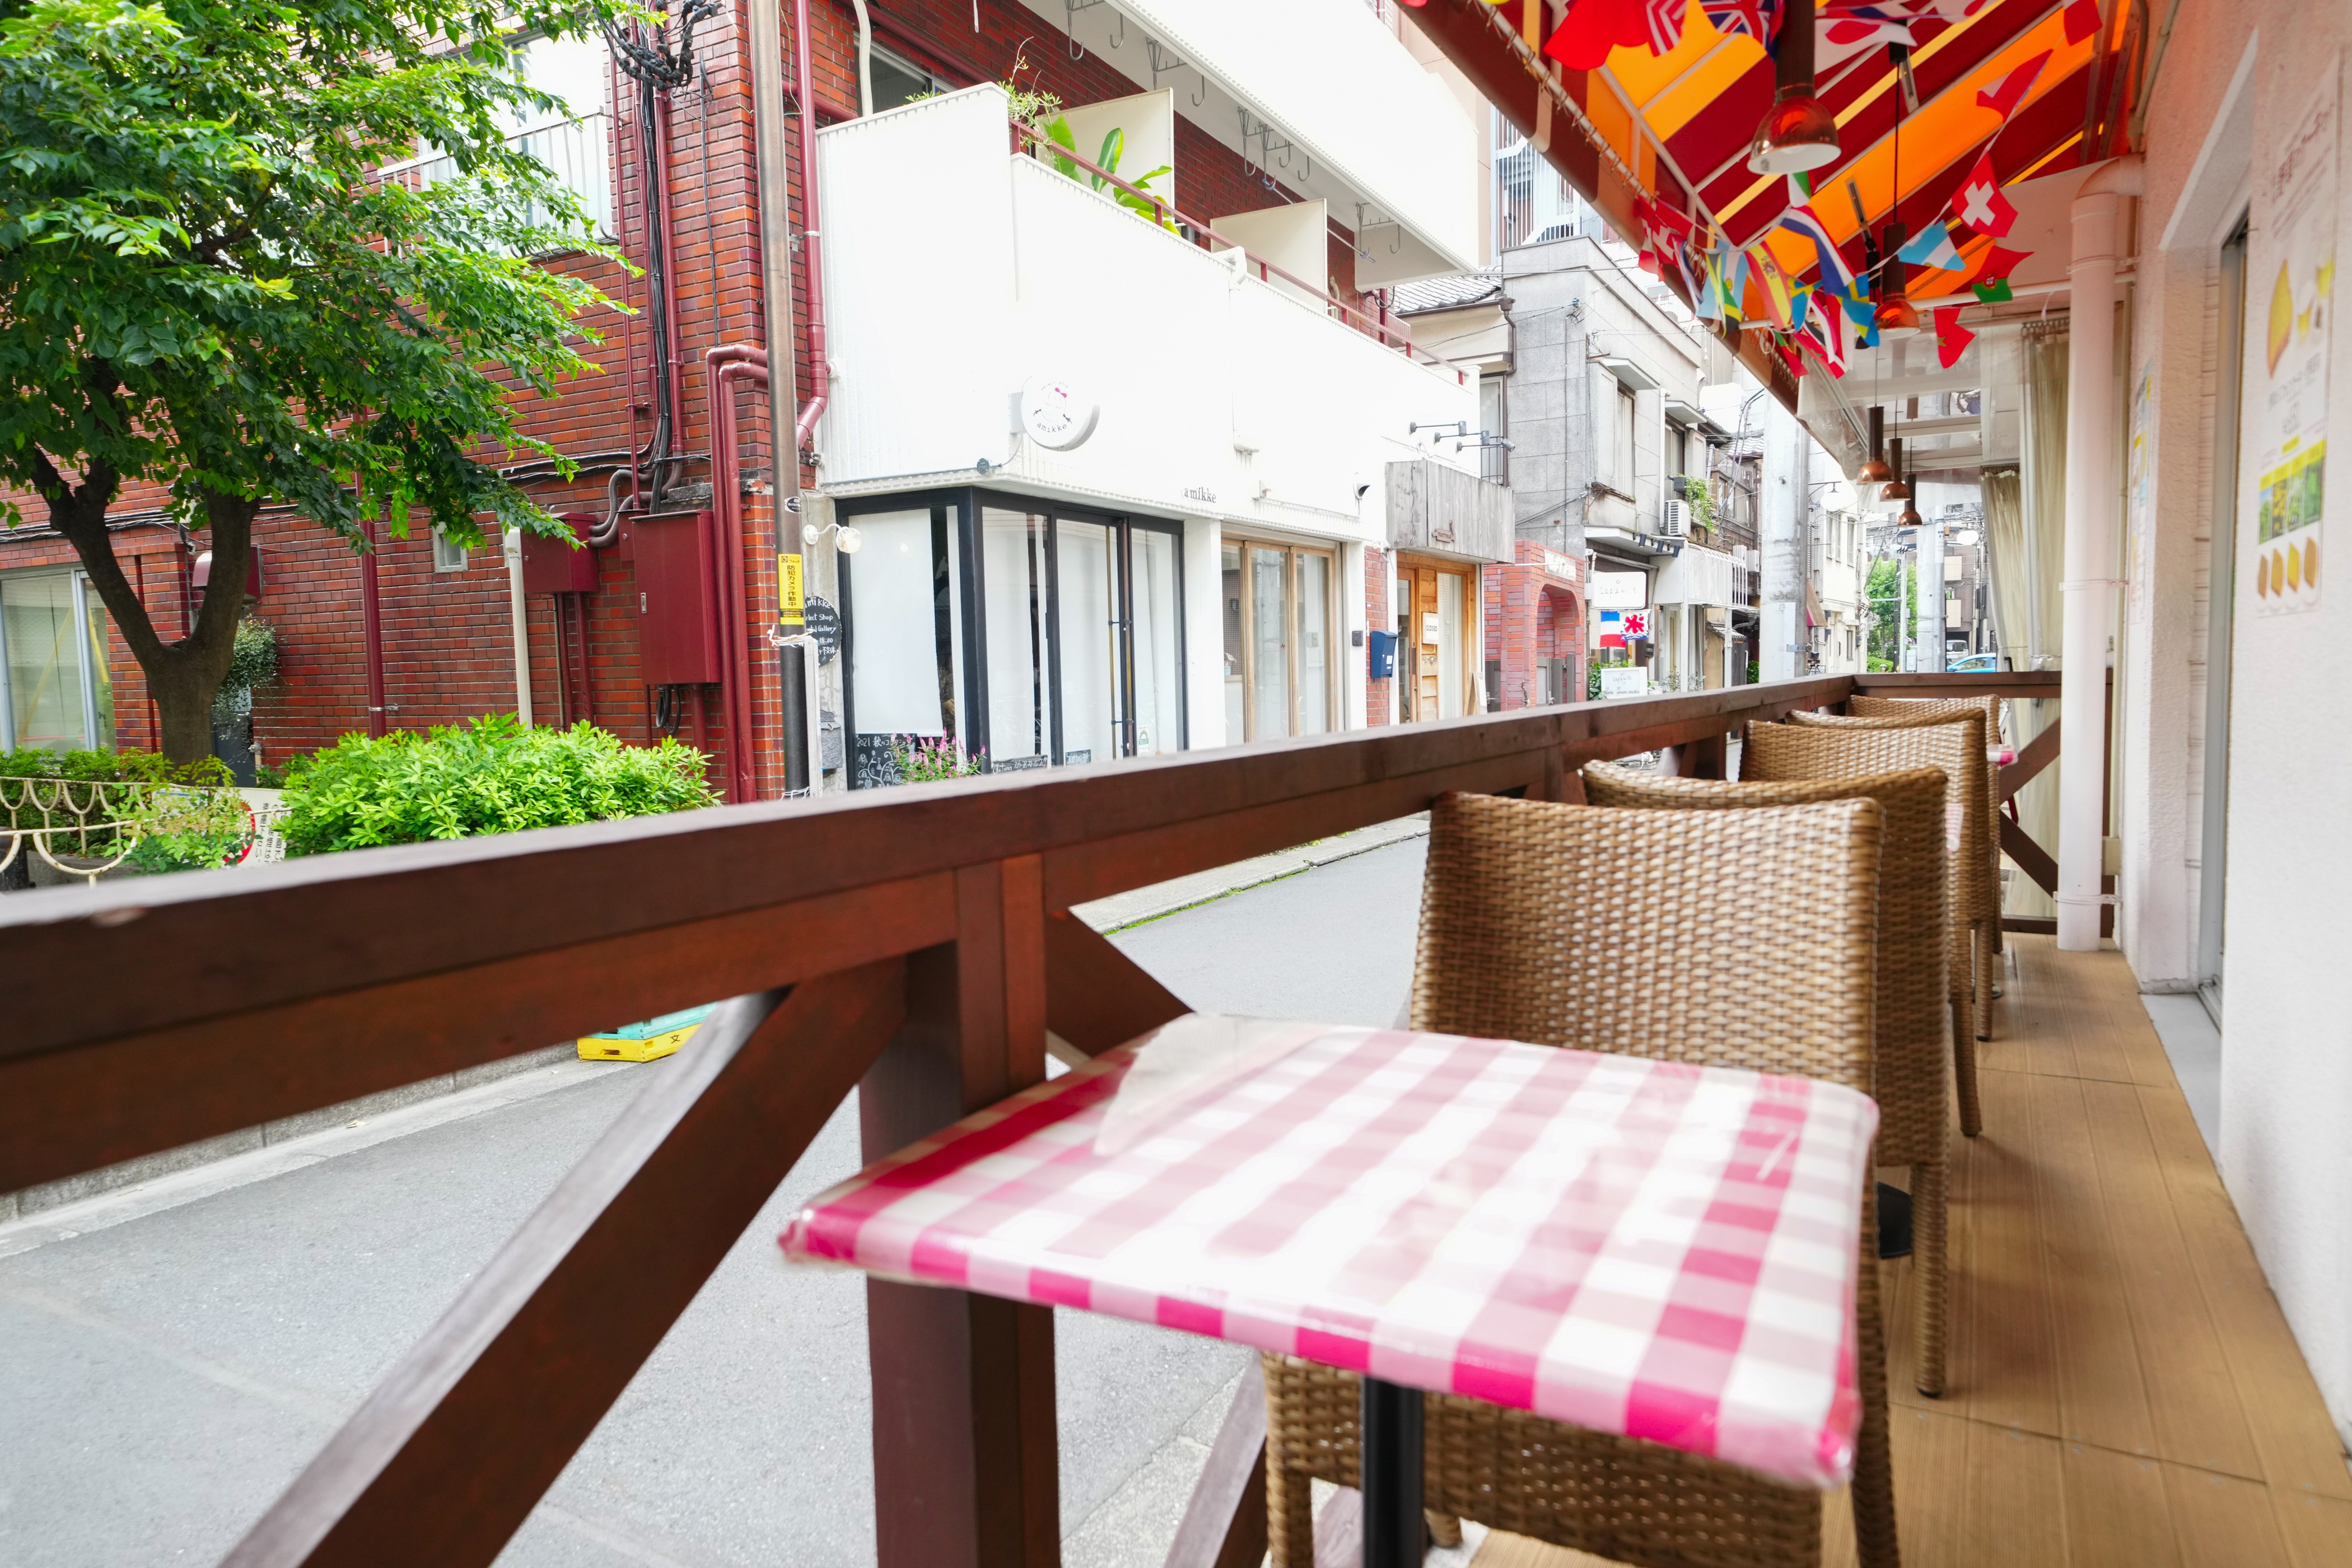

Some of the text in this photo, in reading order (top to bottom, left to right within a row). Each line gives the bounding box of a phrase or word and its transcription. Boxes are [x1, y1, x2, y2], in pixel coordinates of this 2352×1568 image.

[1037, 422, 1067, 432] amikke
[1184, 487, 1216, 503] amikke
[787, 565, 796, 606] 防犯カメラ作動中
[805, 613, 818, 621] elect
[818, 625, 837, 634] Gallery
[857, 737, 870, 747] 2021
